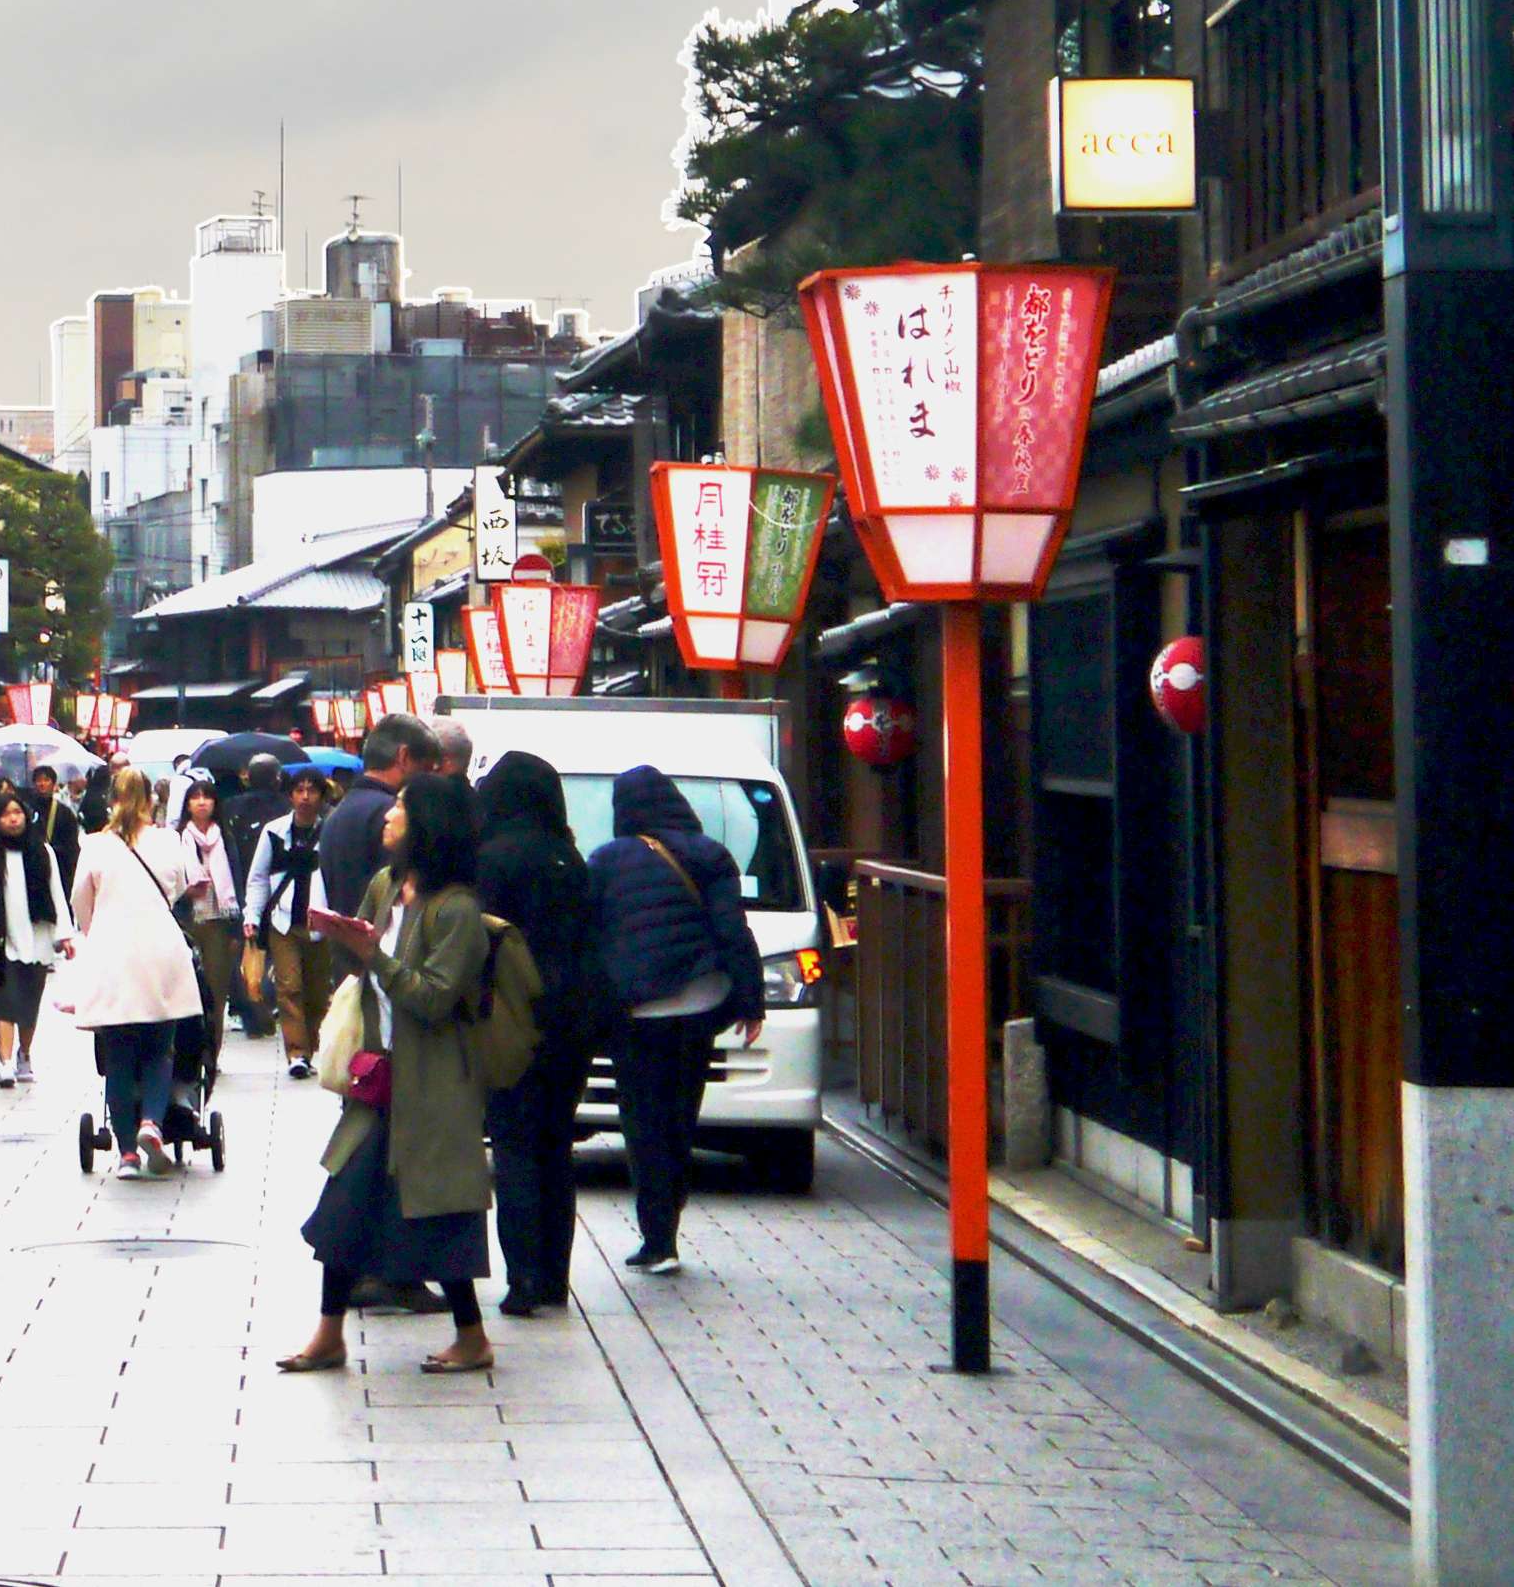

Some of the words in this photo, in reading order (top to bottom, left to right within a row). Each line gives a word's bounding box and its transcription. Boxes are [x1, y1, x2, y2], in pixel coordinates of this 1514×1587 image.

[1080, 129, 1178, 156] acca
[897, 303, 936, 439] はれま
[481, 509, 513, 566] 西坂
[694, 482, 728, 597] 月桂冠
